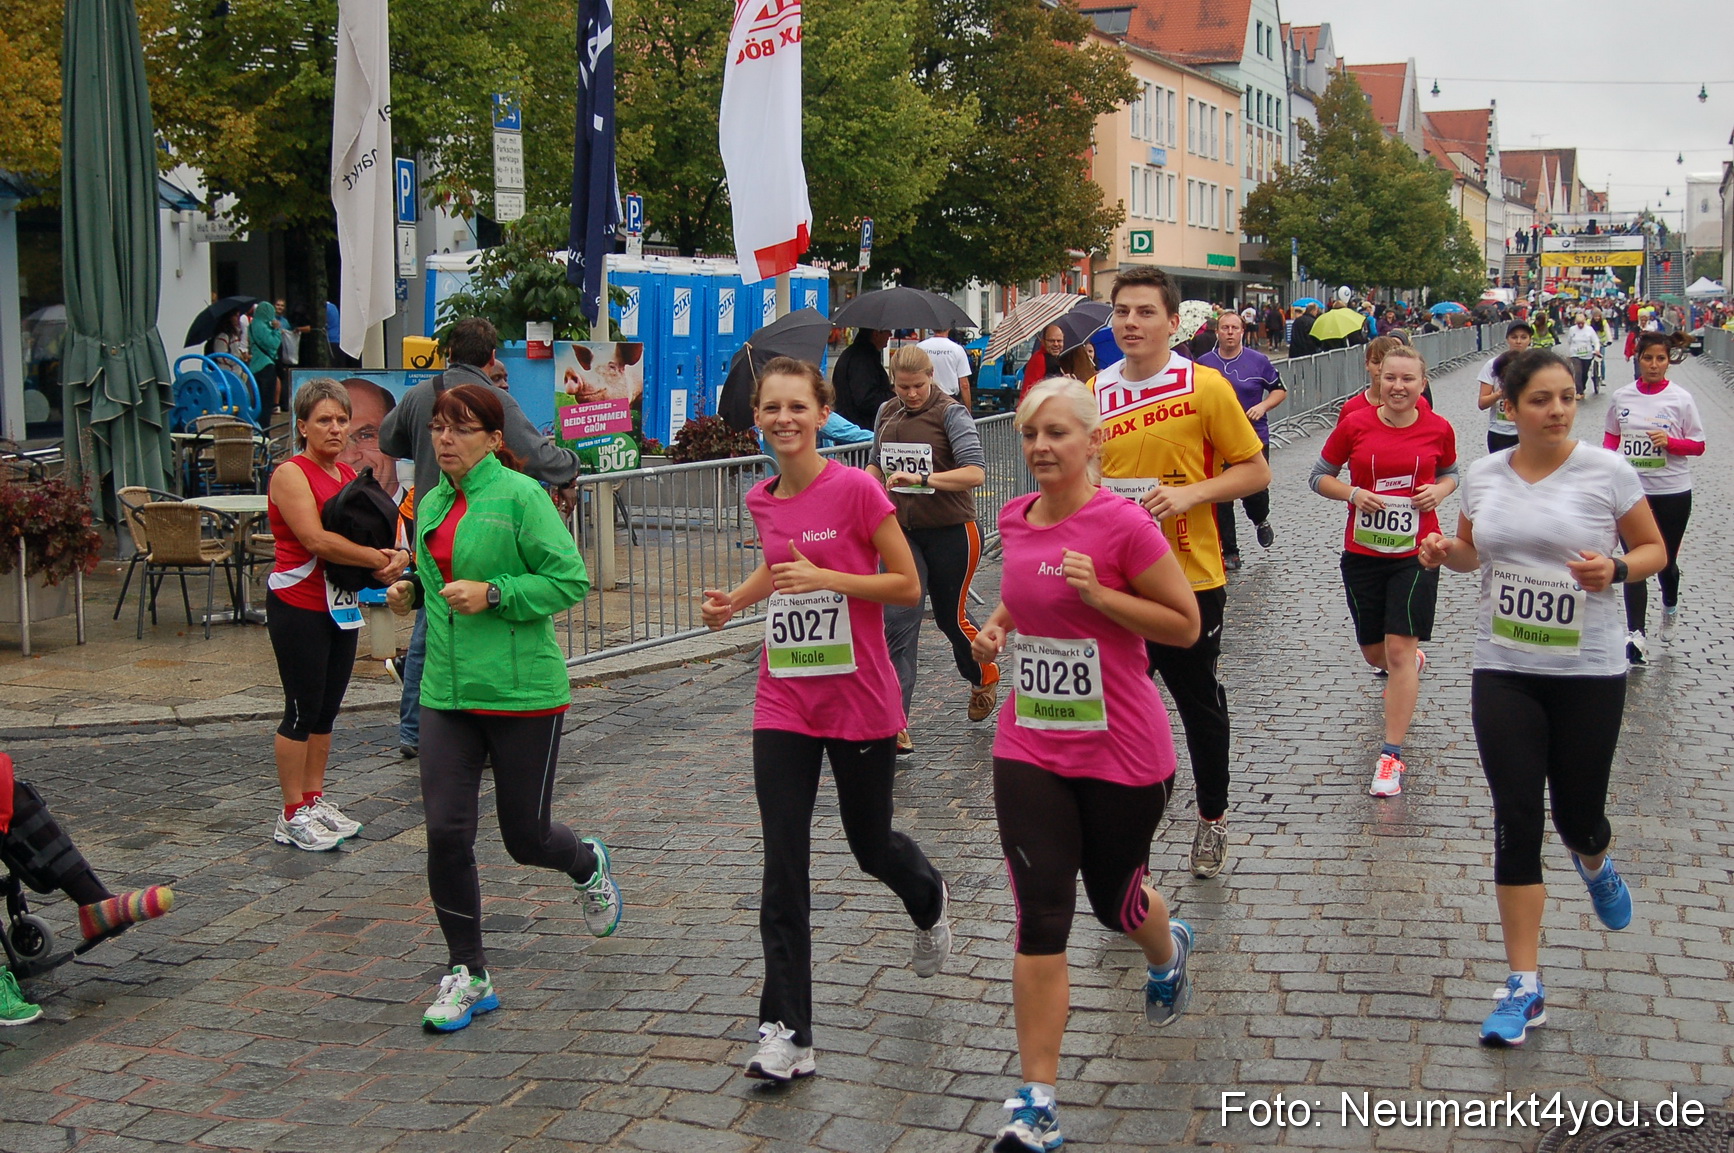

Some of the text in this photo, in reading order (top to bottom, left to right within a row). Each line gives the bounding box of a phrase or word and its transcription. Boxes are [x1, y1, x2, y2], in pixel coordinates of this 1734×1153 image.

[496, 144, 521, 154] Parkschein
[498, 155, 520, 164] werktags
[400, 167, 411, 214] P
[629, 200, 639, 228] P
[863, 223, 871, 247] P
[1133, 233, 1150, 251] D
[1573, 255, 1609, 264] START
[673, 292, 691, 317] DIXI
[719, 292, 735, 317] DIXI
[578, 402, 612, 413] SEPTEMBER
[1143, 401, 1198, 428] BÖGL
[564, 411, 627, 427] BEIDE STIMMEN
[584, 423, 606, 434] GRÜN
[598, 444, 619, 456] UND
[1623, 440, 1663, 457] 5024
[599, 449, 637, 473] DU?
[885, 456, 929, 474] 5154
[1113, 485, 1146, 493] Neumarkt
[1361, 508, 1413, 533] 5063
[802, 527, 837, 543] Nicole
[1372, 534, 1395, 547] Tanja
[1038, 561, 1064, 576] And
[1494, 569, 1569, 589] PARTL Neumarkt
[769, 595, 830, 607] PARTL Neumarkt
[1498, 584, 1576, 625] 5030
[772, 607, 840, 644] 5027
[1512, 625, 1551, 643] Monia
[790, 650, 825, 664] Nicole
[1038, 645, 1080, 657] Neumarkt
[1020, 656, 1092, 696] 5028
[1033, 702, 1076, 718] Andrea
